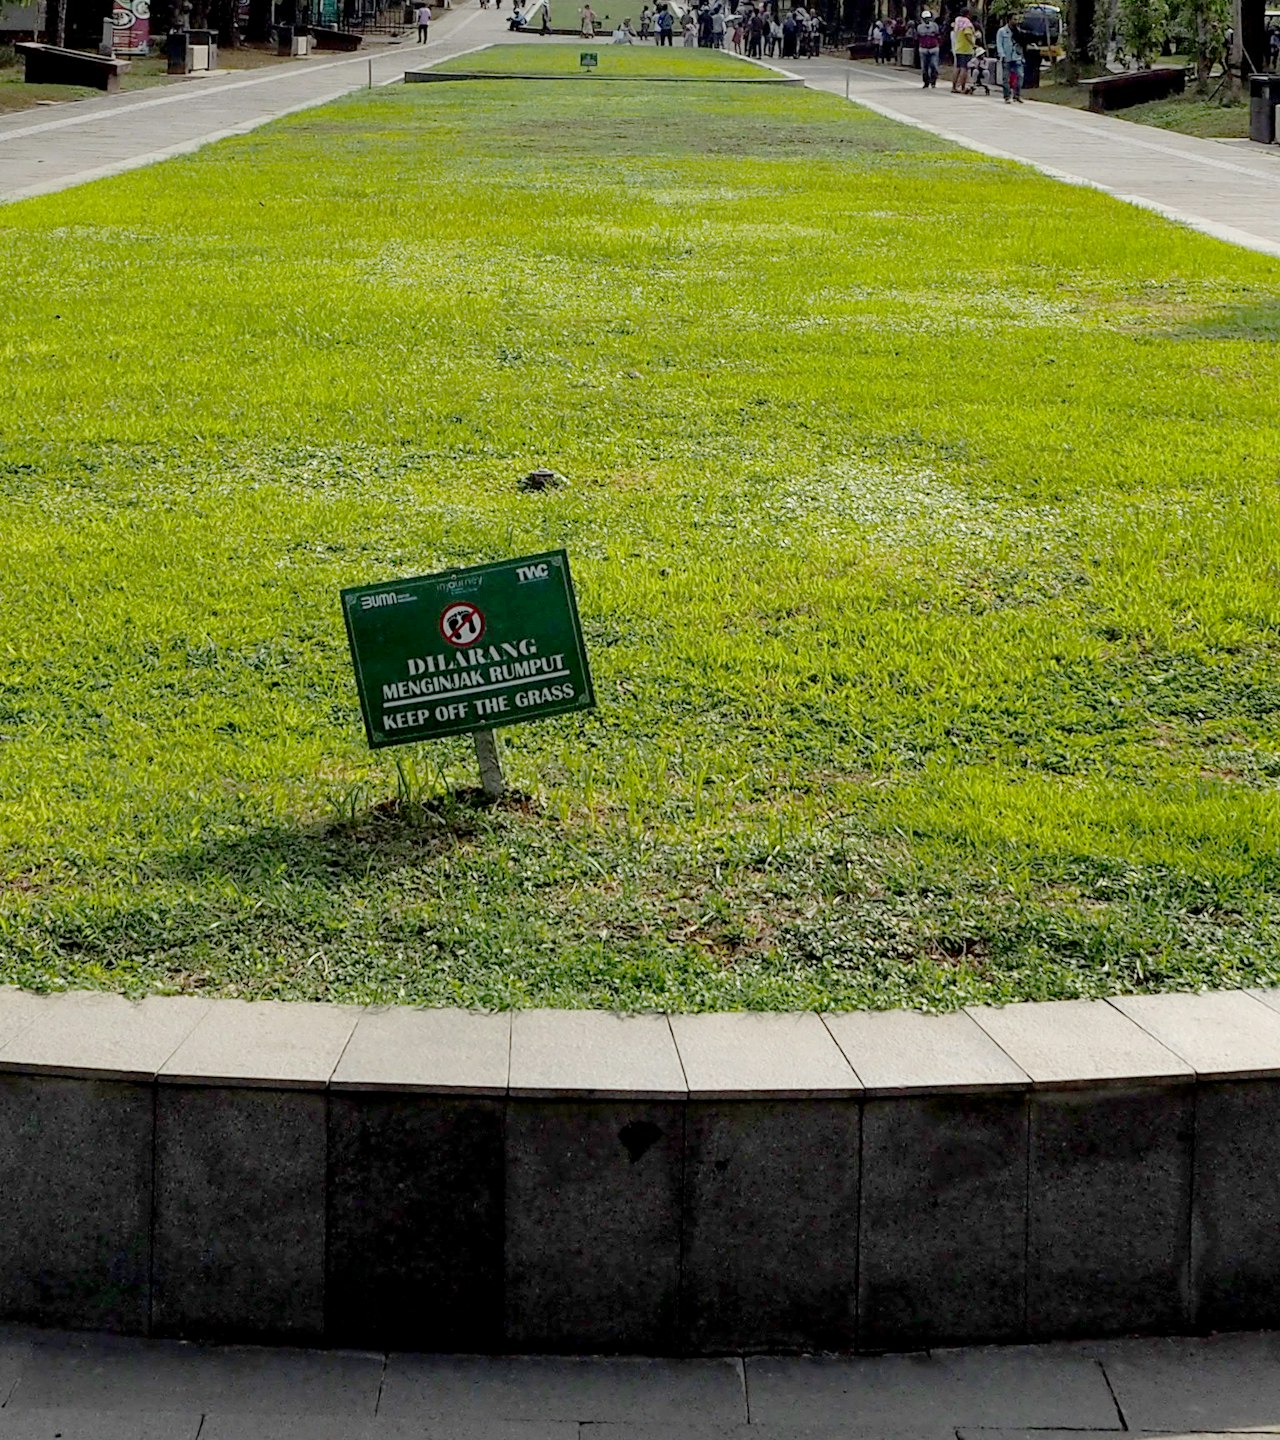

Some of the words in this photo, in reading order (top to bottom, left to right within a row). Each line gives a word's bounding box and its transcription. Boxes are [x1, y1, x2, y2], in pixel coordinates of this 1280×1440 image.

[516, 563, 549, 582] TWC
[382, 669, 485, 700] MENGINJAK
[489, 653, 565, 682] RUMPUT
[407, 638, 537, 676] DILARANG
[382, 709, 430, 730] KEEP
[435, 702, 469, 722] OFF
[473, 695, 510, 715] THE
[515, 683, 575, 708] GRASS
